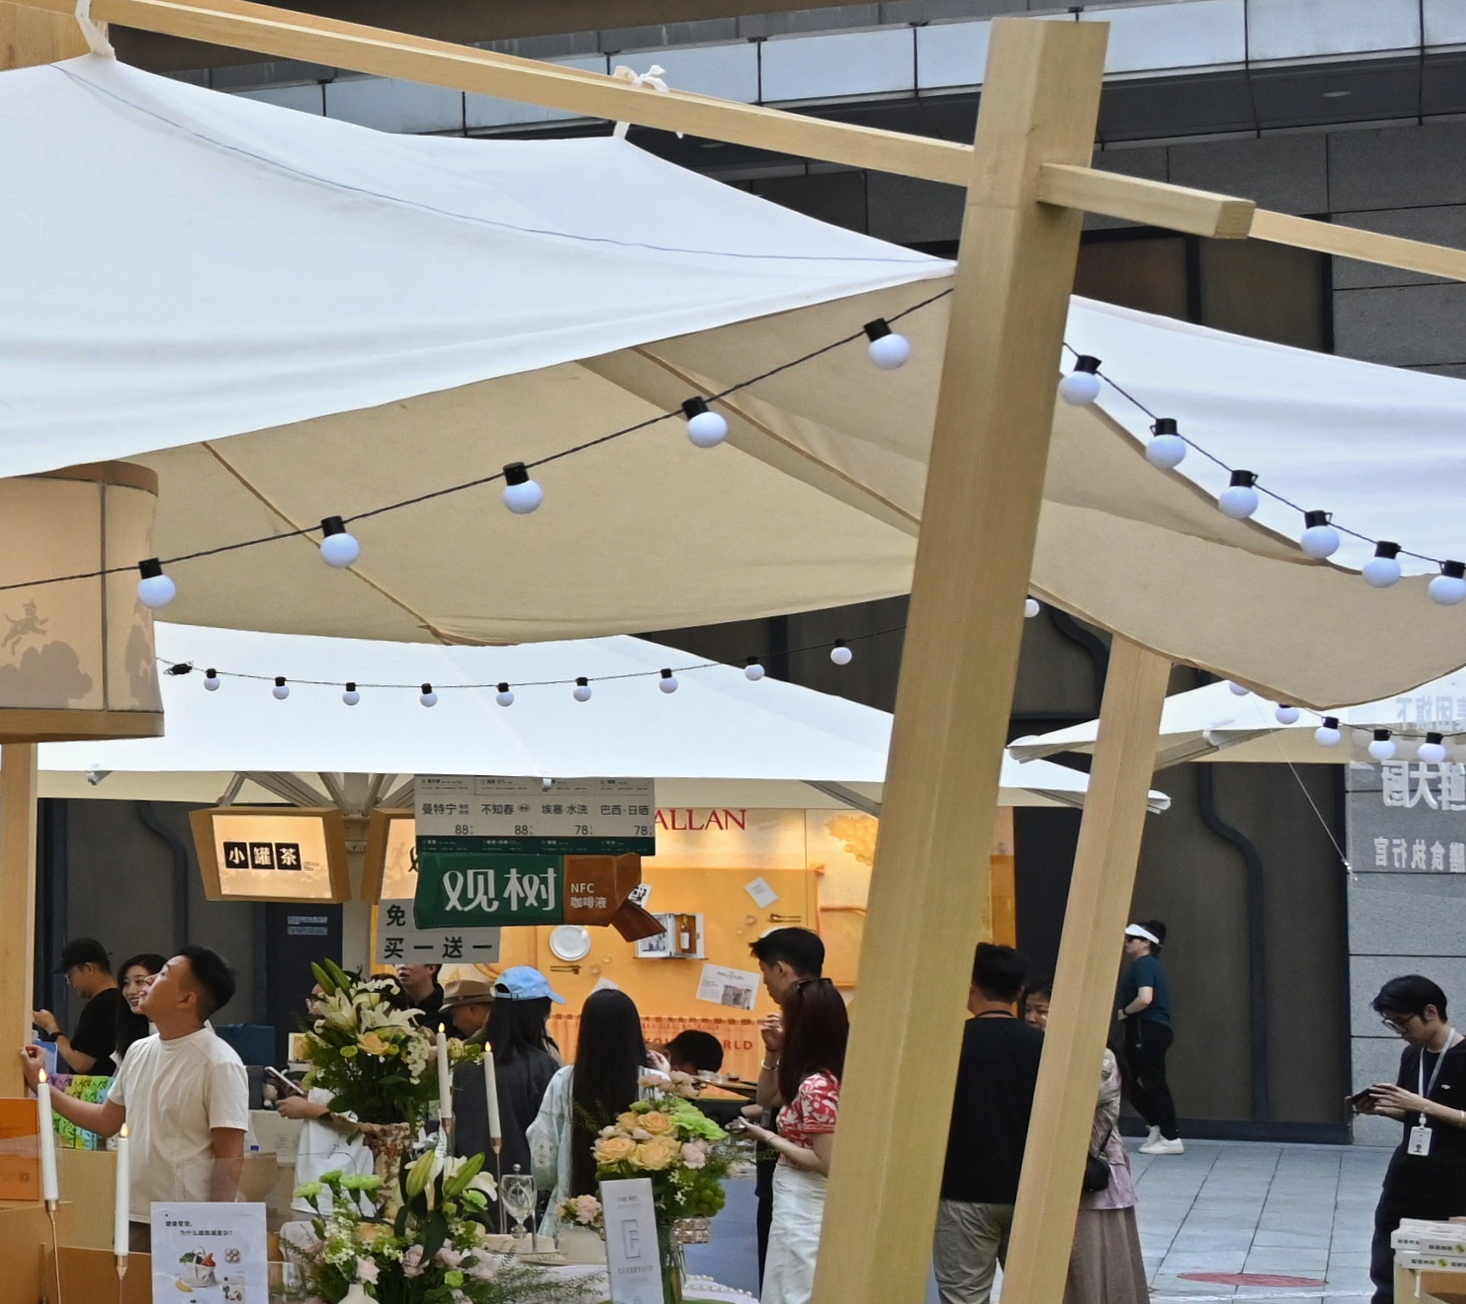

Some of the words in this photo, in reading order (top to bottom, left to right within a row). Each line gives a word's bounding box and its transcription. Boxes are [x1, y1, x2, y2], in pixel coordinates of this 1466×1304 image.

[422, 803, 457, 815] 曼特宁
[481, 804, 514, 815] 不知春
[455, 824, 469, 835] 88
[515, 824, 529, 835] 88
[574, 824, 588, 835] 78
[634, 825, 648, 835] 78
[228, 846, 298, 866] 小罐茶
[442, 867, 557, 913] 观树
[570, 882, 595, 894] NFC
[570, 897, 607, 910] 咖啡液
[384, 936, 493, 959] 买一送一
